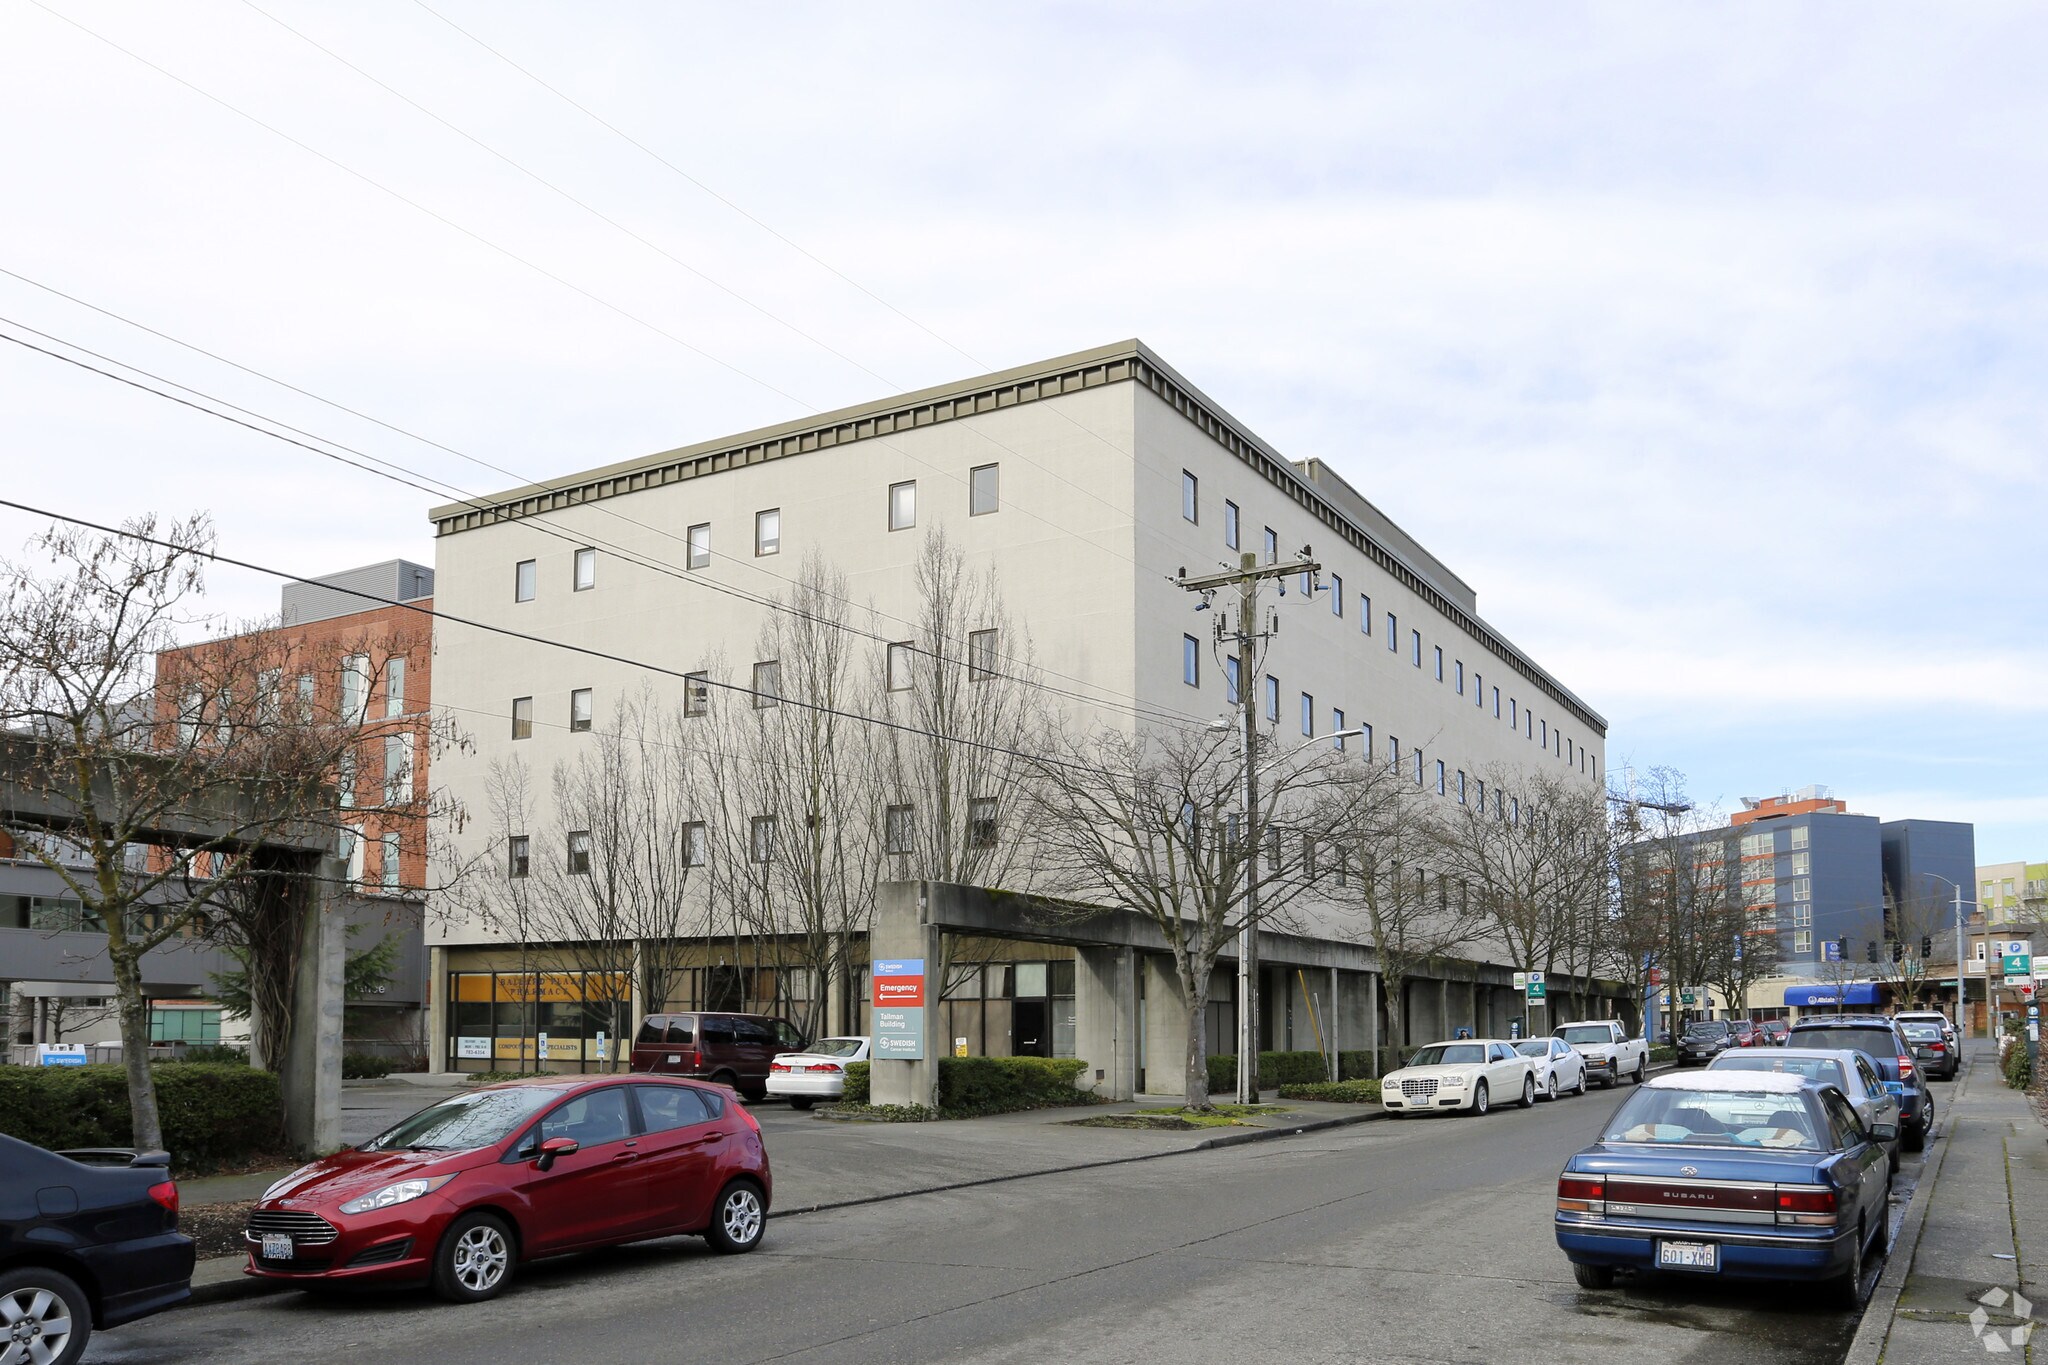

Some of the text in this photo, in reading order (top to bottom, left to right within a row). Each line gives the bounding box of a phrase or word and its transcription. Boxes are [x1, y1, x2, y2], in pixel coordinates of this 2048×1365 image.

[2012, 944, 2020, 952] P
[2011, 957, 2022, 967] 4
[880, 984, 917, 993] Emergency
[1532, 984, 1540, 992] 4
[880, 1021, 905, 1029] Building
[889, 1039, 916, 1047] SWEDISH
[1663, 1191, 1715, 1200] SUBARU
